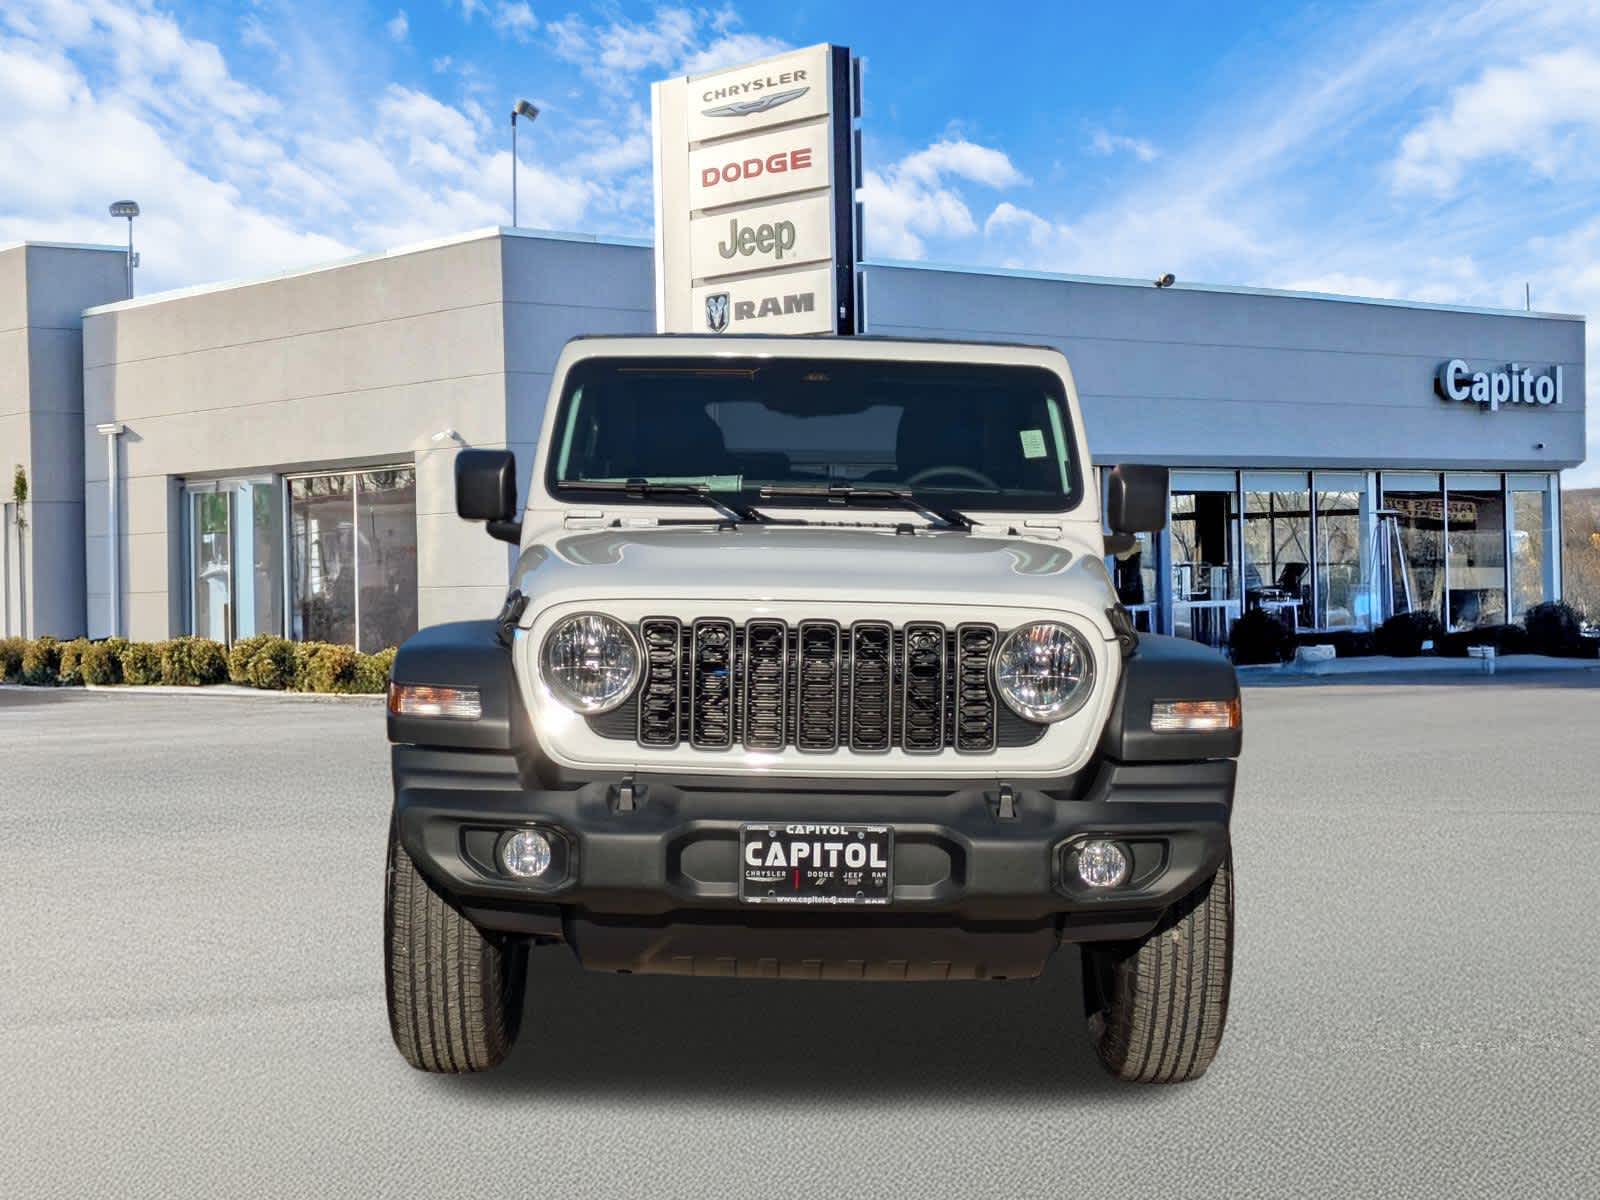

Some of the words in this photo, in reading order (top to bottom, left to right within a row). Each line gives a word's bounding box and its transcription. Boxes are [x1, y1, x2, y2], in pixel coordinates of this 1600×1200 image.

[702, 69, 808, 103] CHRYSLER
[701, 148, 812, 188] DODGE
[719, 218, 796, 260] Jeep
[734, 292, 815, 321] RAM
[1446, 359, 1563, 411] Capitol
[786, 825, 849, 835] CAPITOL
[745, 841, 887, 868] CAPITOL
